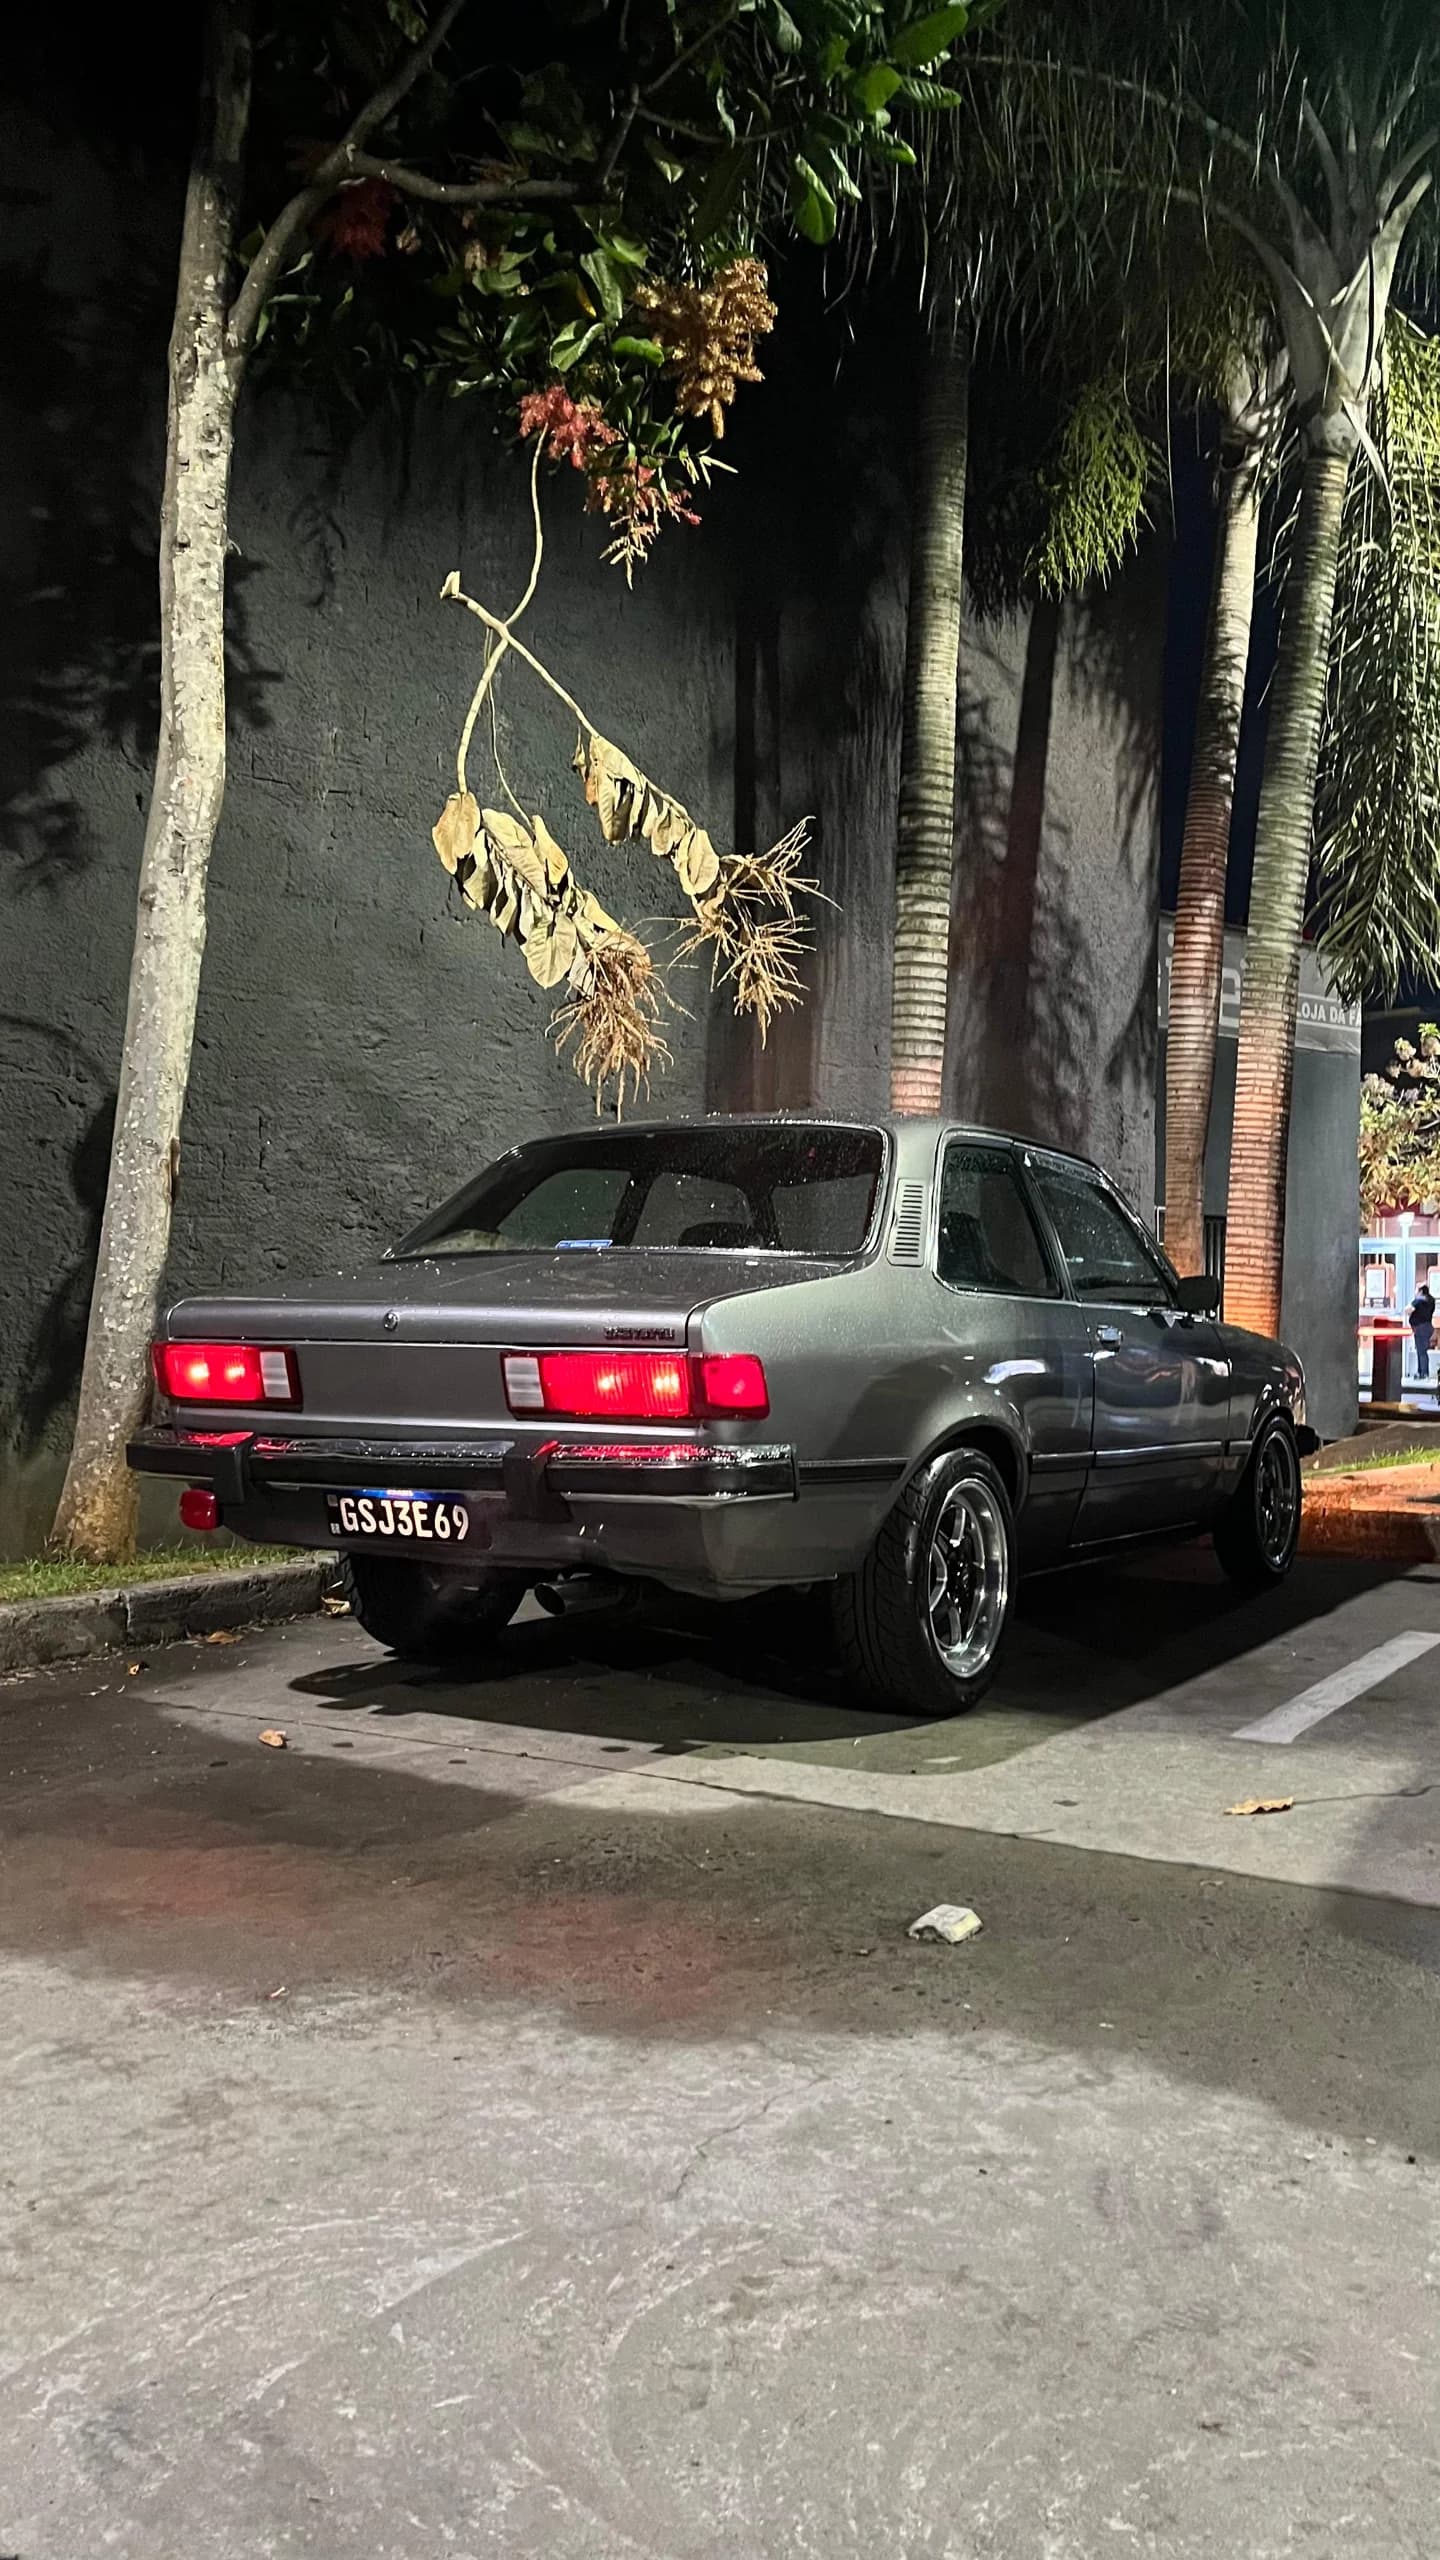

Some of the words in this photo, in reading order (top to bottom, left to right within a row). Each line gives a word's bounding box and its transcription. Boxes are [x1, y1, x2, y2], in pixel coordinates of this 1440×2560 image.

[1297, 1002, 1326, 1022] OJA
[1330, 1006, 1346, 1025] DA
[339, 1497, 469, 1540] GSJ3E69
